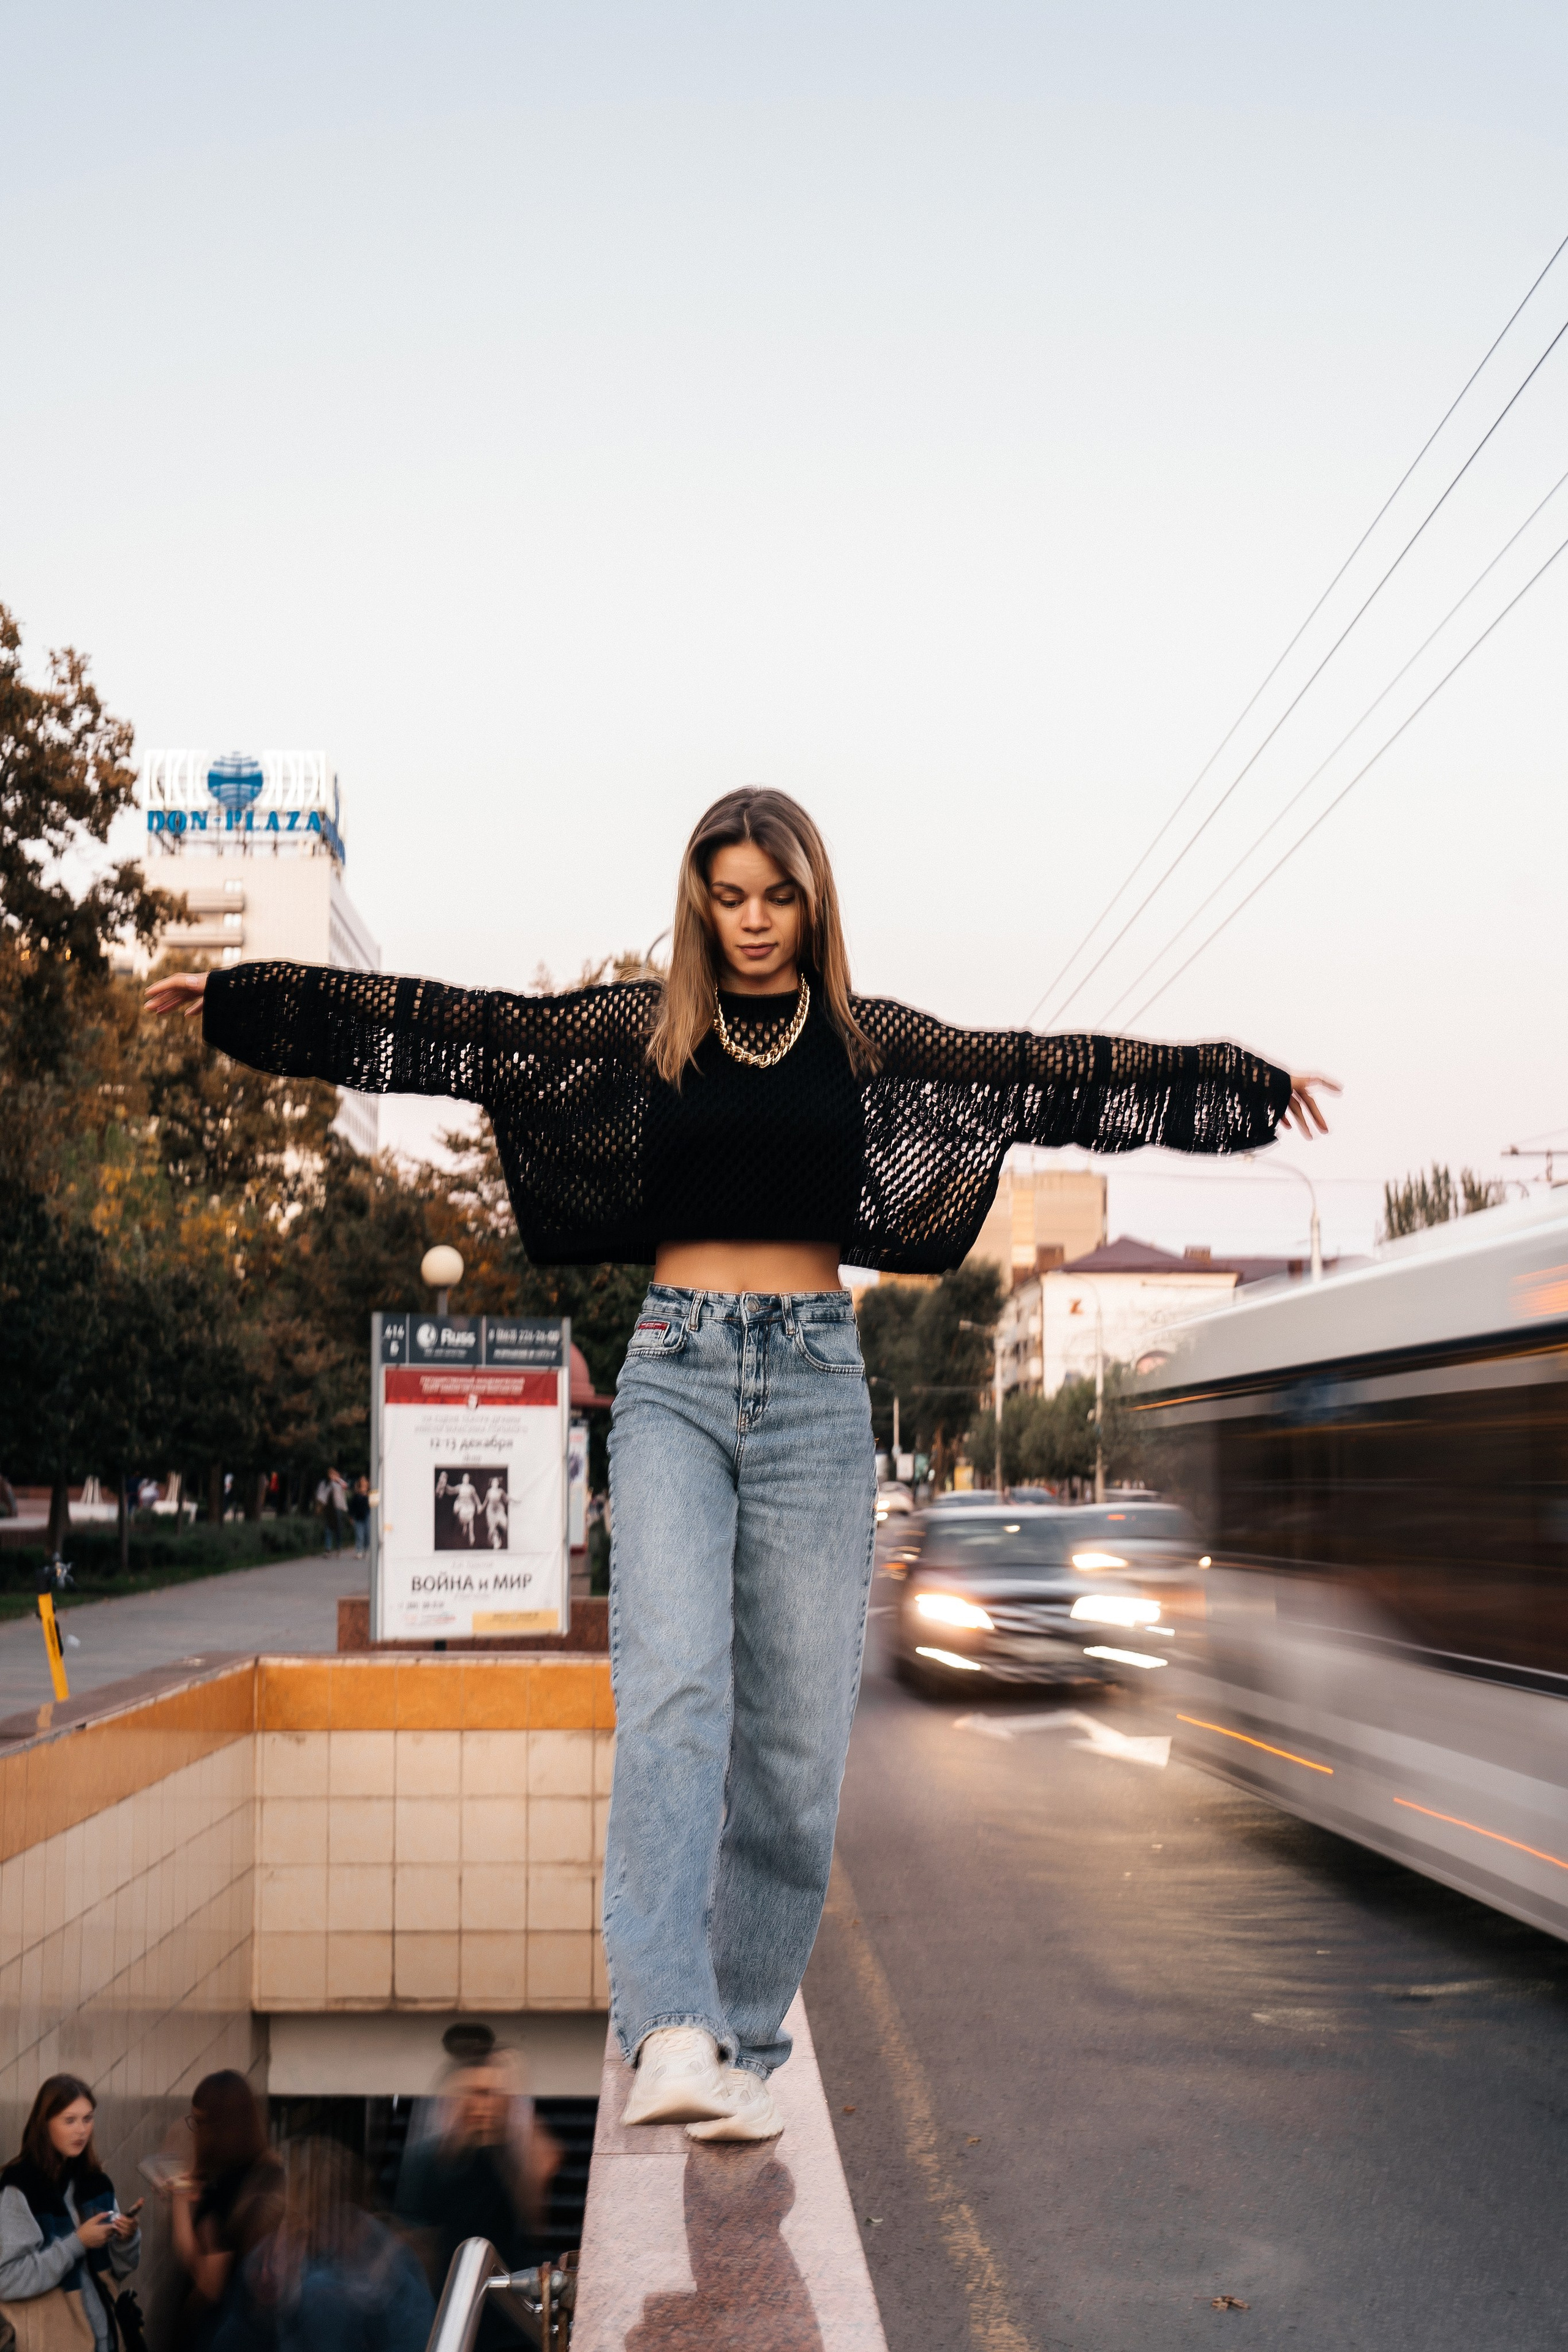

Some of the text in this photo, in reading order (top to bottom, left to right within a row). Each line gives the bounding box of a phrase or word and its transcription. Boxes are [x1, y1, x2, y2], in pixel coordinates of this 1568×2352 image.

[147, 810, 322, 834] DON PLAZA
[411, 1571, 532, 1593] ВОЙНА и МИР
